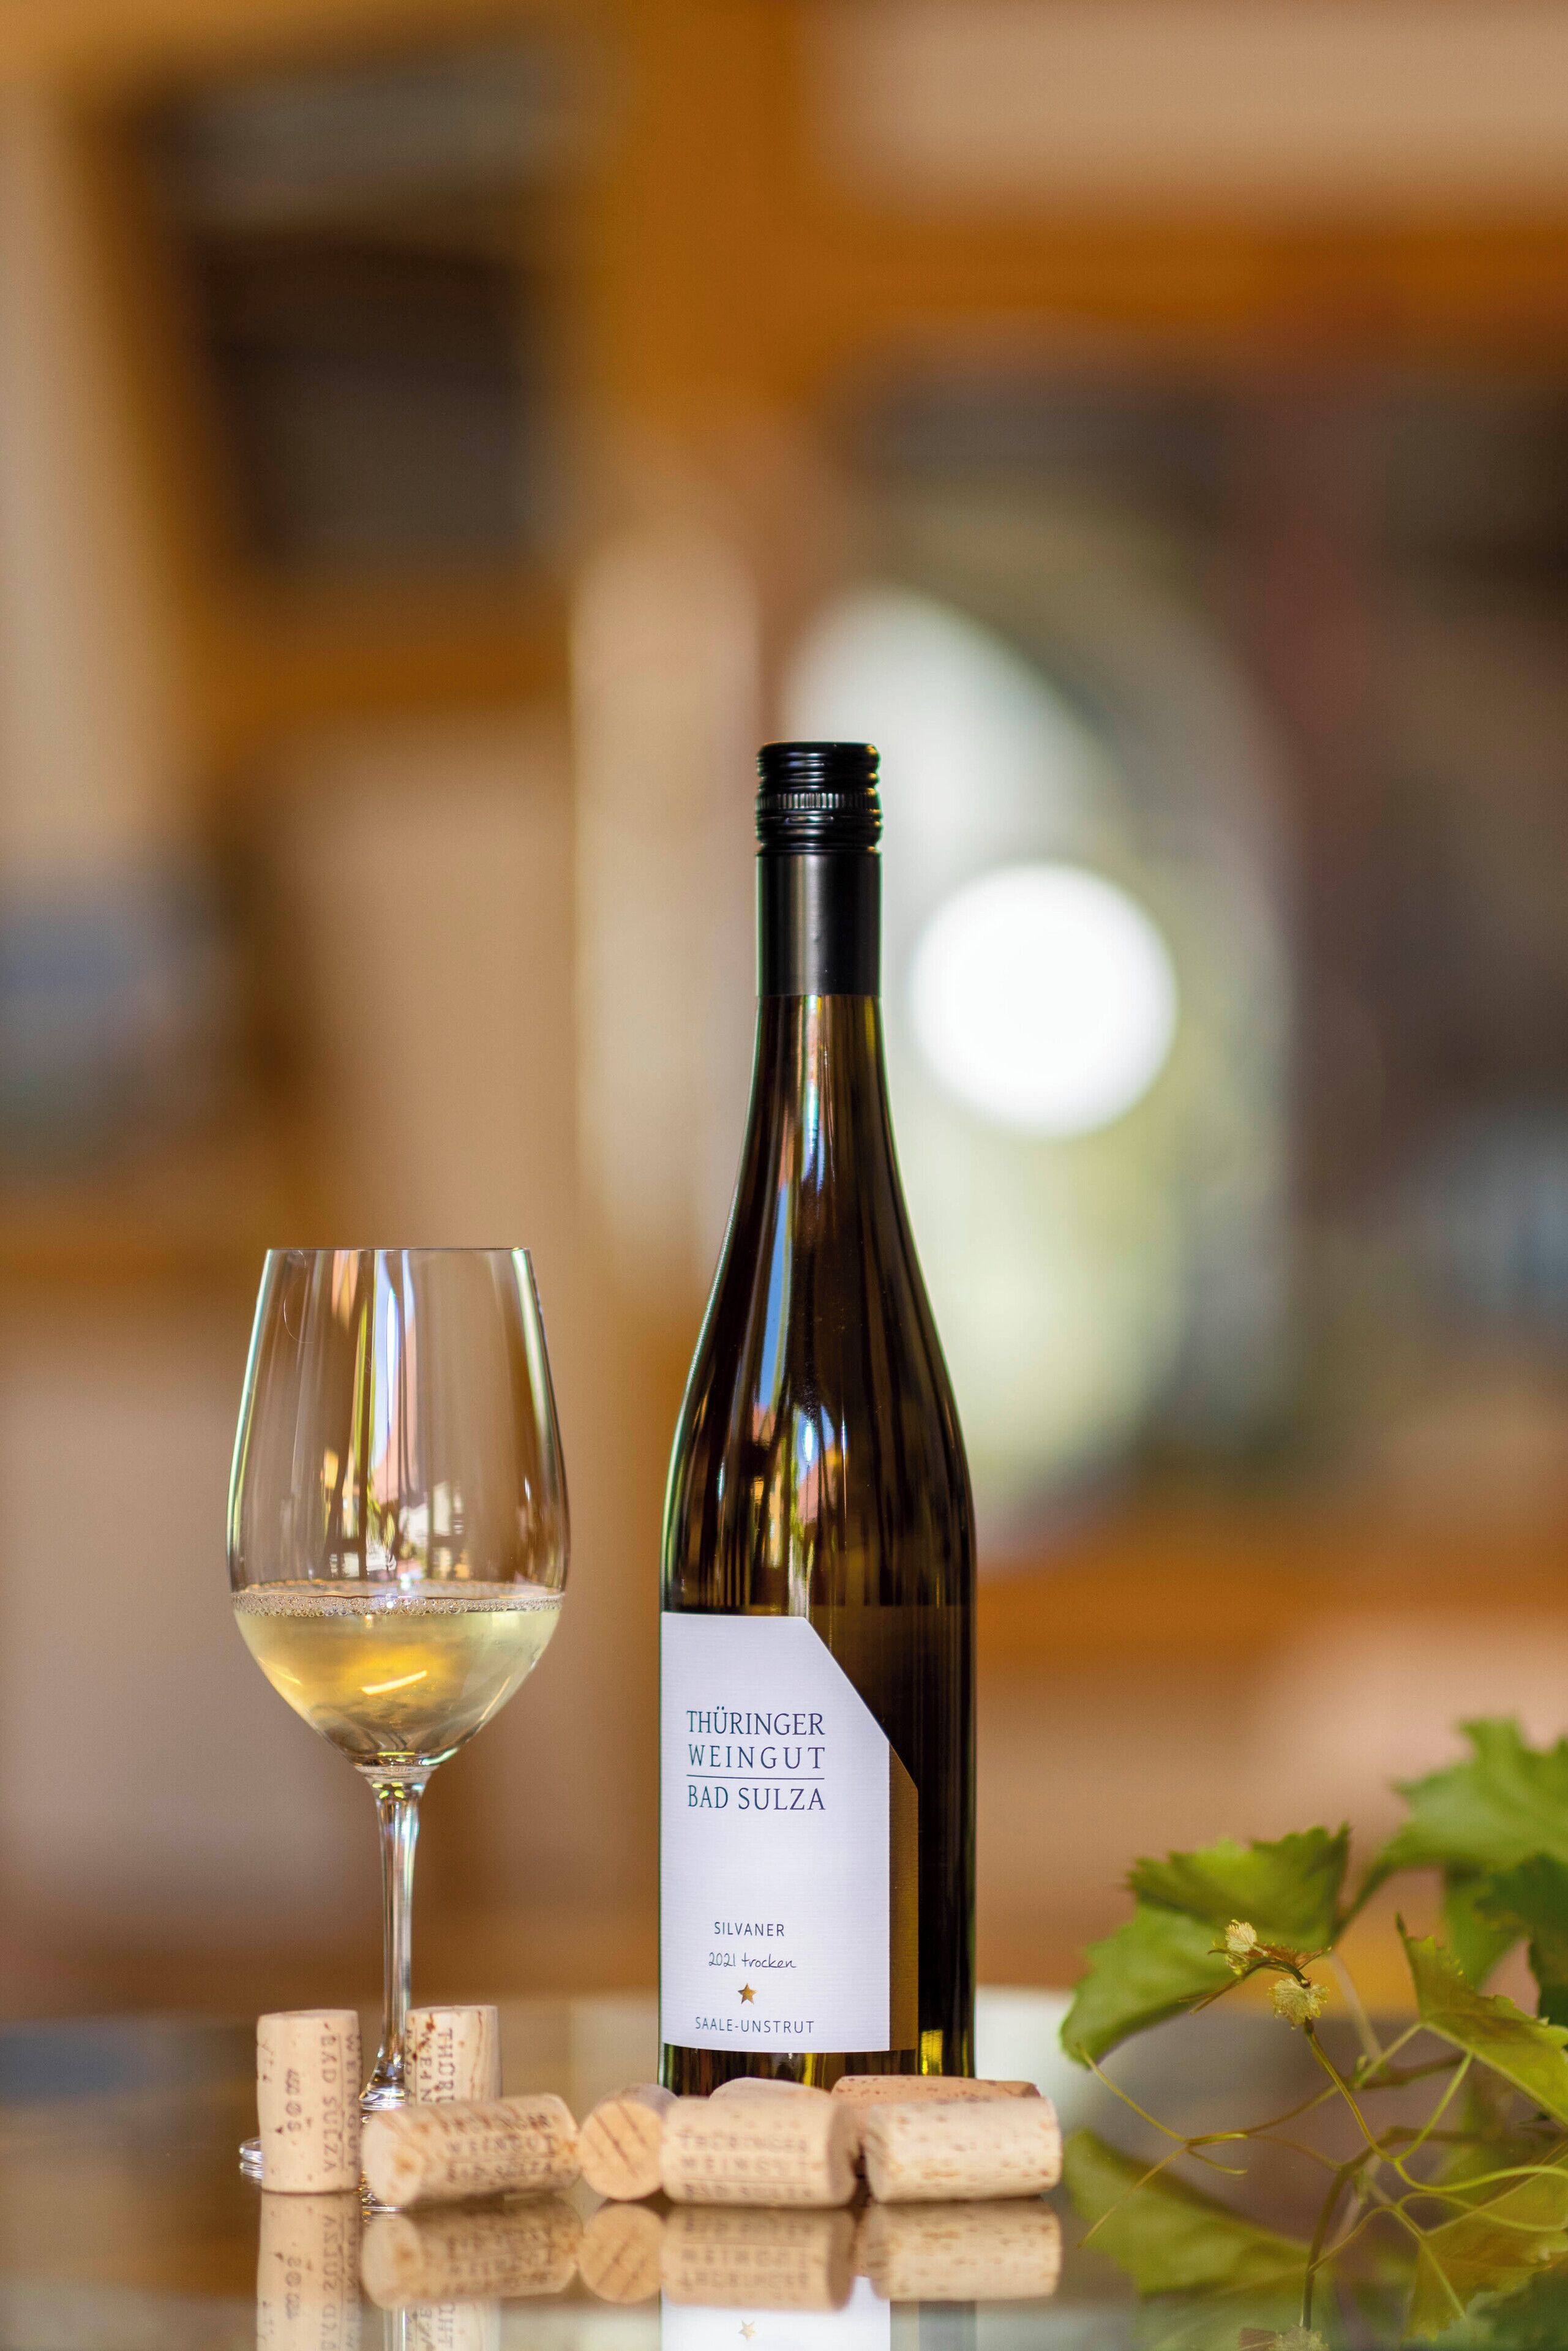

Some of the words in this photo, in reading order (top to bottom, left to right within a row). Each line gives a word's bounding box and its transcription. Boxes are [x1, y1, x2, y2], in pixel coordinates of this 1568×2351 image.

[686, 1706, 825, 1735] THÜRINGER
[688, 1744, 825, 1769] WEINGUT
[688, 1785, 729, 1809] BAD
[738, 1787, 826, 1810] SULZA
[714, 1921, 785, 1937] SILVANER
[708, 1952, 736, 1967] 2021
[741, 1952, 797, 1968] trocken
[696, 2016, 814, 2033] SAALE-UNSTRUT
[321, 2035, 337, 2082] BAD
[322, 2095, 338, 2172] SULZA
